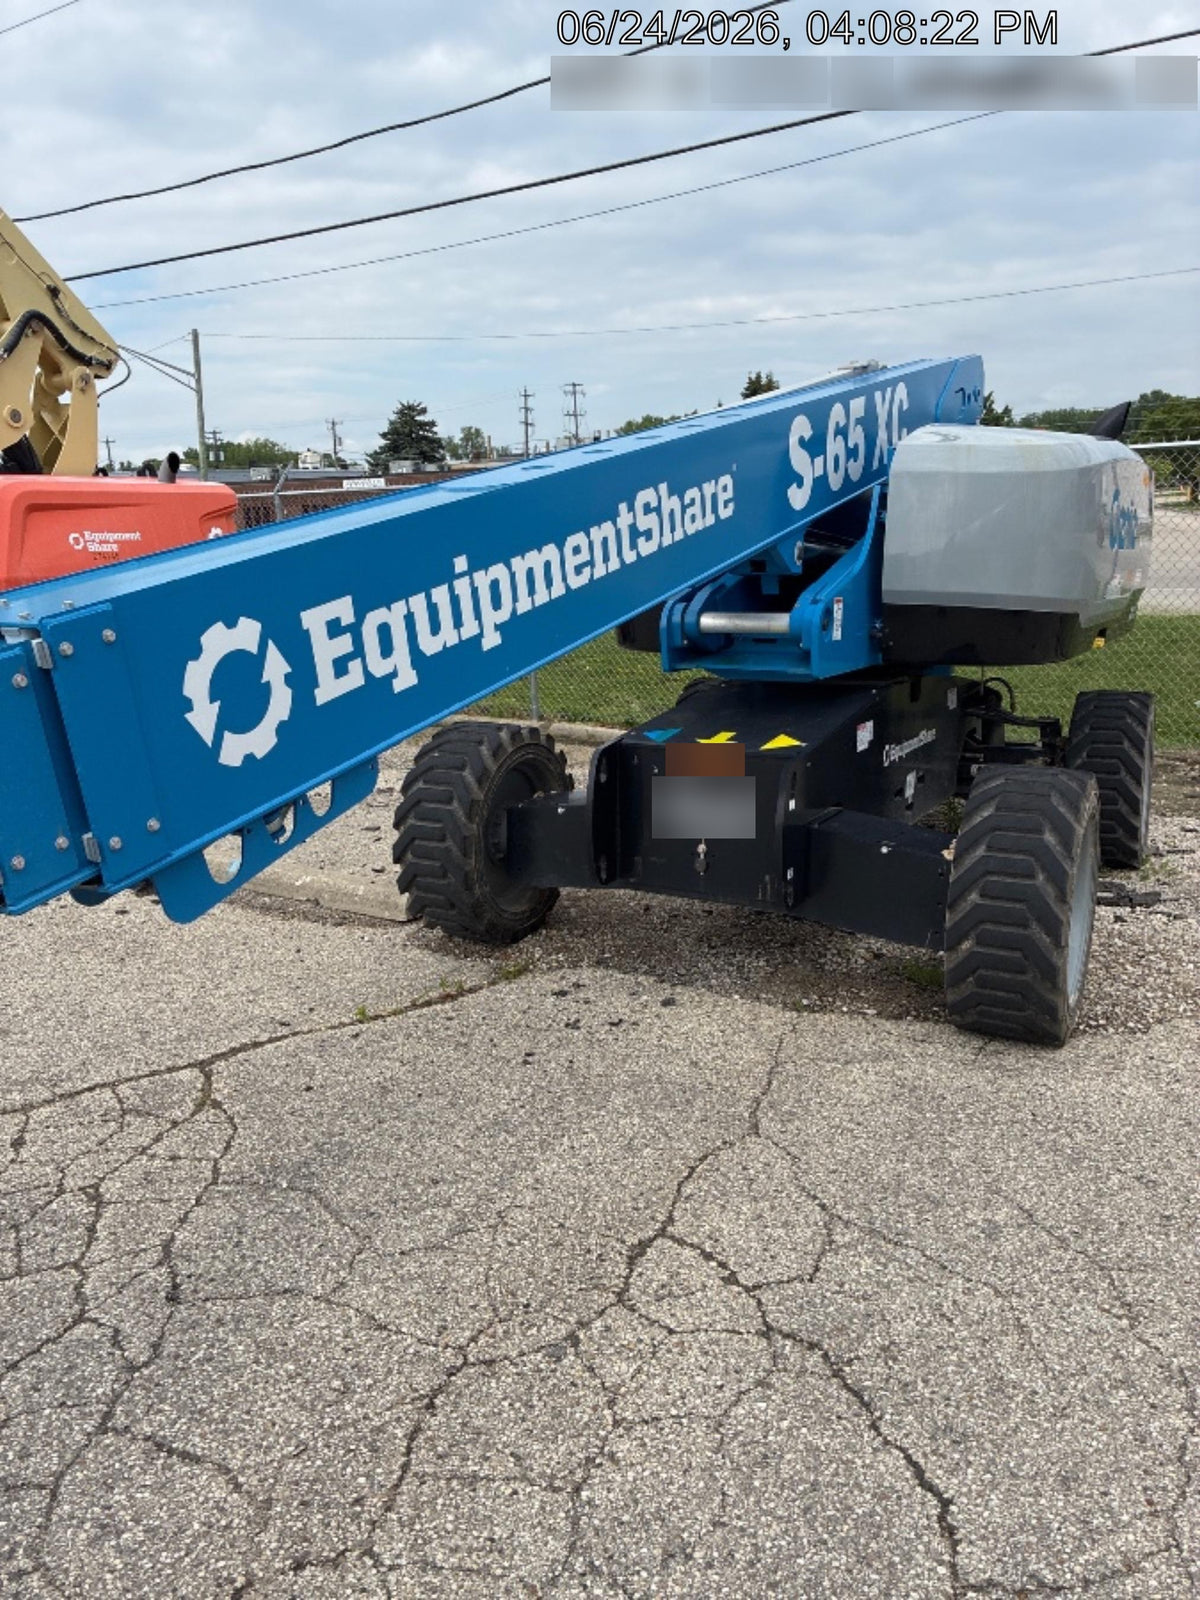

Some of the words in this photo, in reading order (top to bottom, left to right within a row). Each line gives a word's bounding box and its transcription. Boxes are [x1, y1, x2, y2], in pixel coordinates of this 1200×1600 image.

[787, 396, 865, 511] S-65
[872, 382, 909, 471] XC
[83, 531, 141, 542] Equipment
[86, 542, 118, 552] Share
[300, 473, 735, 706] EquipmentShare
